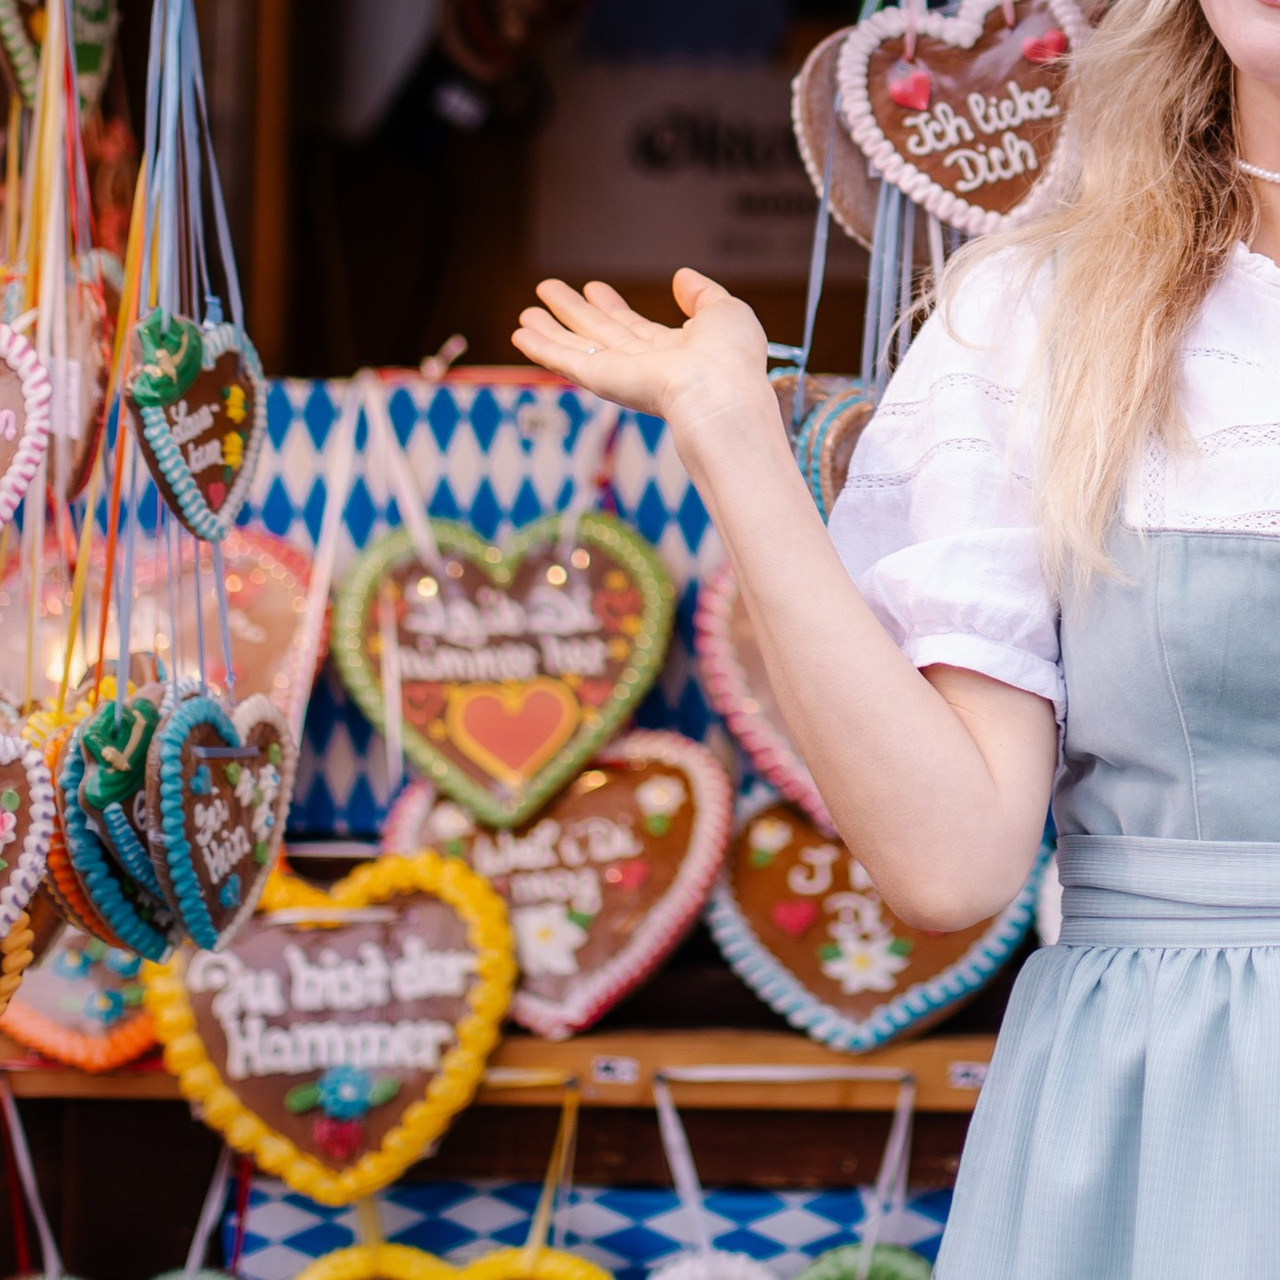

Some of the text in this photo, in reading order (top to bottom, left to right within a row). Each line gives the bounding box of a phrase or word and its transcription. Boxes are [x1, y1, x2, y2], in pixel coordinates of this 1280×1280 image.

[904, 80, 1061, 156] Ich liebe
[943, 131, 1039, 193] Dich
[283, 941, 391, 1012] bist
[389, 934, 480, 1002] der
[221, 1017, 456, 1081] Hammer
